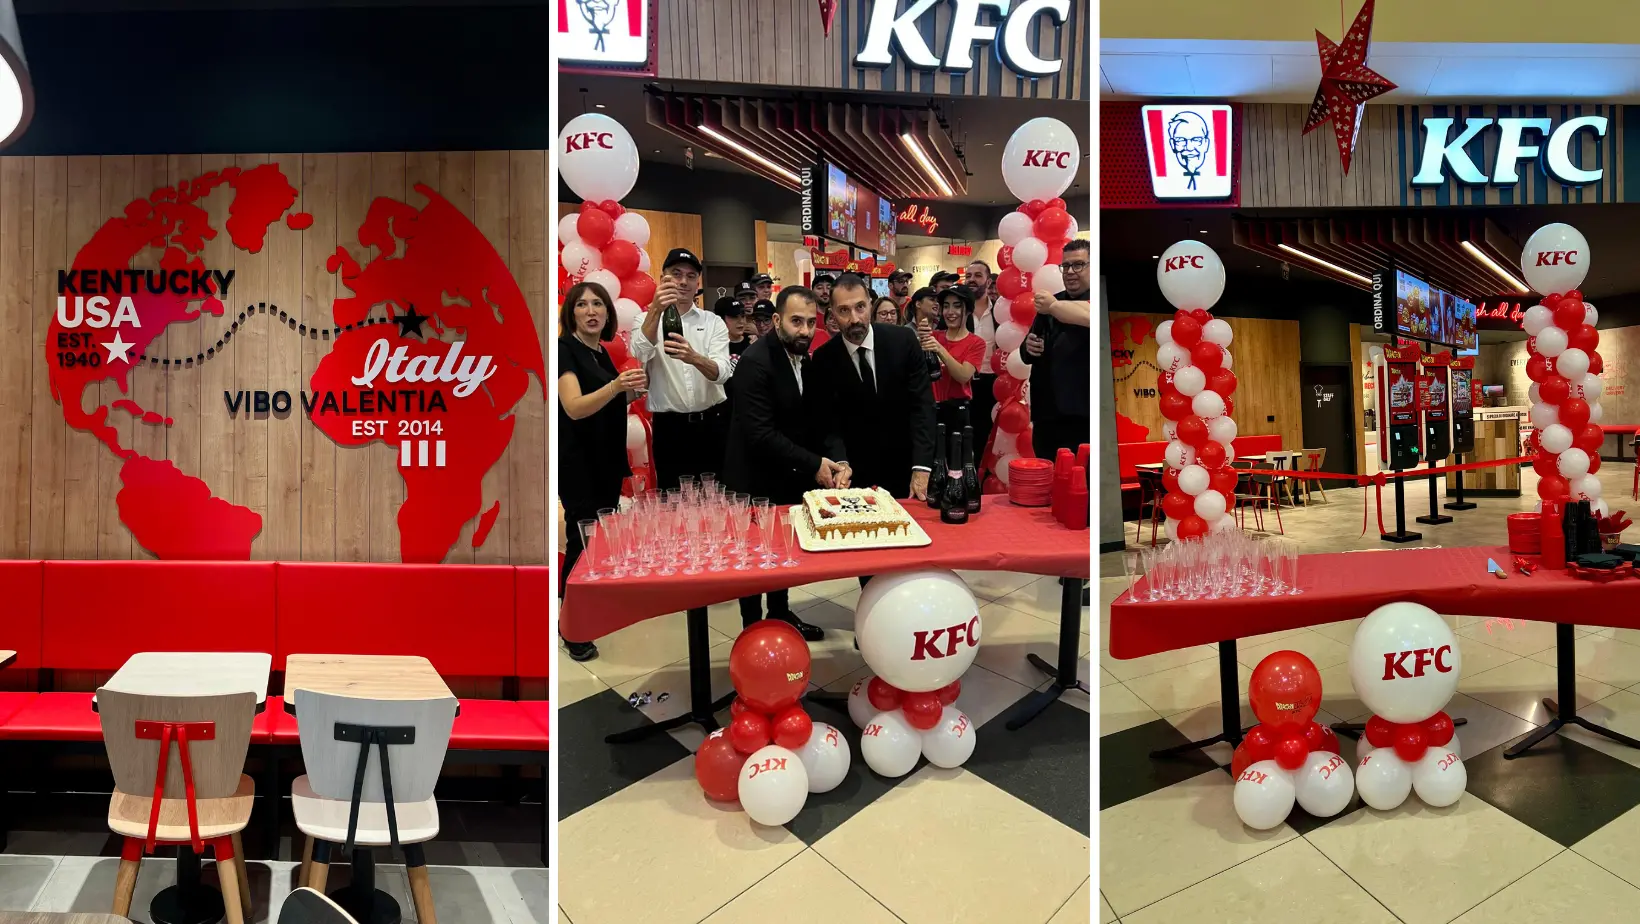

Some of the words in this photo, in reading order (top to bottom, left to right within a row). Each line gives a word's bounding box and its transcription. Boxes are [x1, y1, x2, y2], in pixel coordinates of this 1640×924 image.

[855, 0, 1068, 77] KFC
[565, 132, 613, 153] KFC
[1023, 150, 1070, 168] KFC
[1411, 116, 1608, 188] KFC
[802, 167, 811, 185] QUI
[802, 187, 812, 231] ORDINA
[900, 204, 917, 222] all
[920, 206, 939, 234] day
[577, 258, 589, 275] KFC
[1164, 255, 1204, 273] KFC
[1535, 250, 1578, 267] KFC
[57, 269, 235, 296] KENTUCKY
[1373, 273, 1382, 289] QUI
[57, 296, 141, 328] USA
[1374, 290, 1382, 330] ORDINA
[1491, 301, 1508, 319] all
[57, 332, 96, 350] EST.
[57, 351, 100, 369] 1940
[351, 338, 498, 397] Italy
[1169, 356, 1180, 371] KFC
[224, 390, 292, 414] VIBO
[300, 390, 447, 413] VALENTIA
[1134, 388, 1156, 398] VIBO
[352, 420, 388, 436] EST
[398, 419, 443, 436] 2014
[1169, 430, 1177, 440] FC
[1180, 449, 1188, 465] KFC
[910, 616, 980, 661] KFC
[1382, 645, 1452, 680] KFC
[826, 724, 839, 747] FC
[863, 724, 883, 737] KF
[749, 757, 788, 780] KFC
[1319, 755, 1344, 779] KFC
[1437, 752, 1460, 771] KFC
[1236, 769, 1268, 785] KFC
